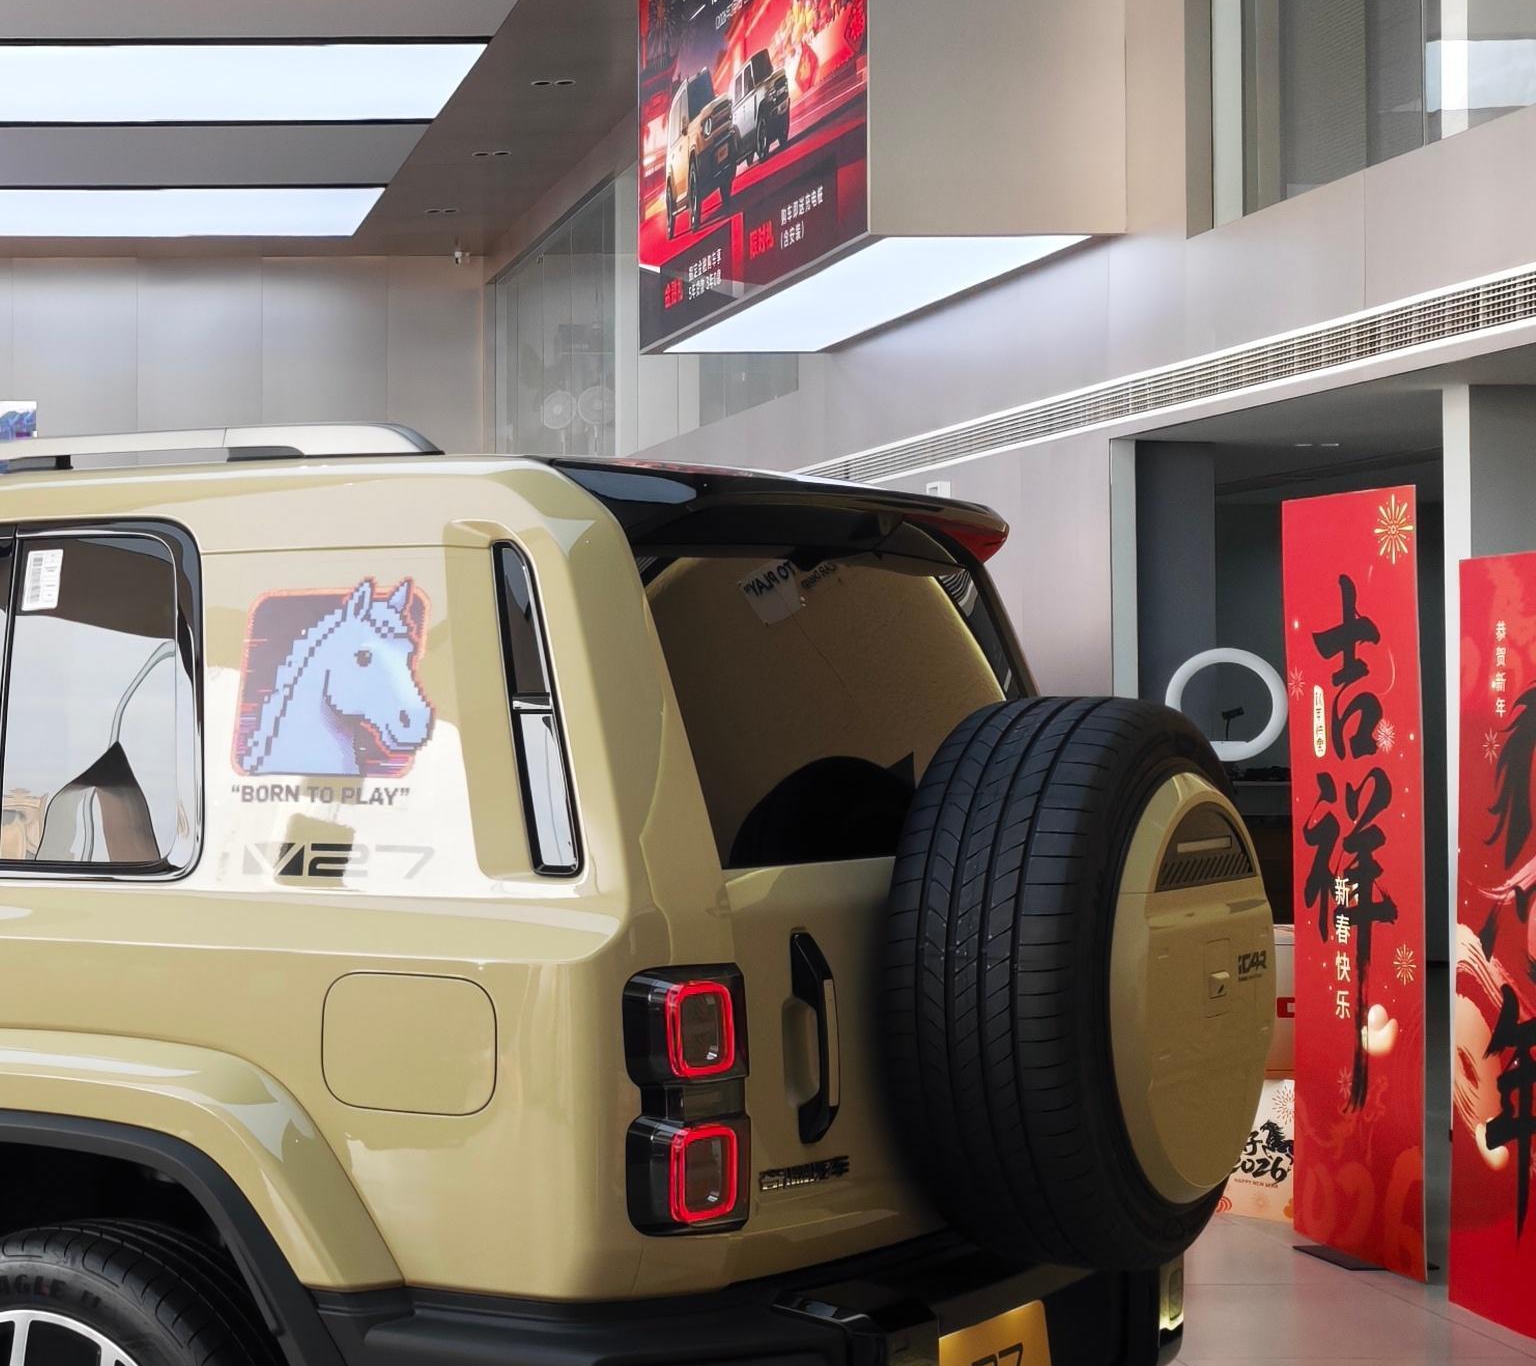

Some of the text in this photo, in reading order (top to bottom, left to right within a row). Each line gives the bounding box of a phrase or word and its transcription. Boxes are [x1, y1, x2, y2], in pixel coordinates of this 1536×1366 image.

[1495, 620, 1507, 719] 恭贺新年
[307, 786, 334, 804] TO
[1303, 574, 1398, 1113] 吉祥
[1334, 875, 1352, 1020] 新春快乐
